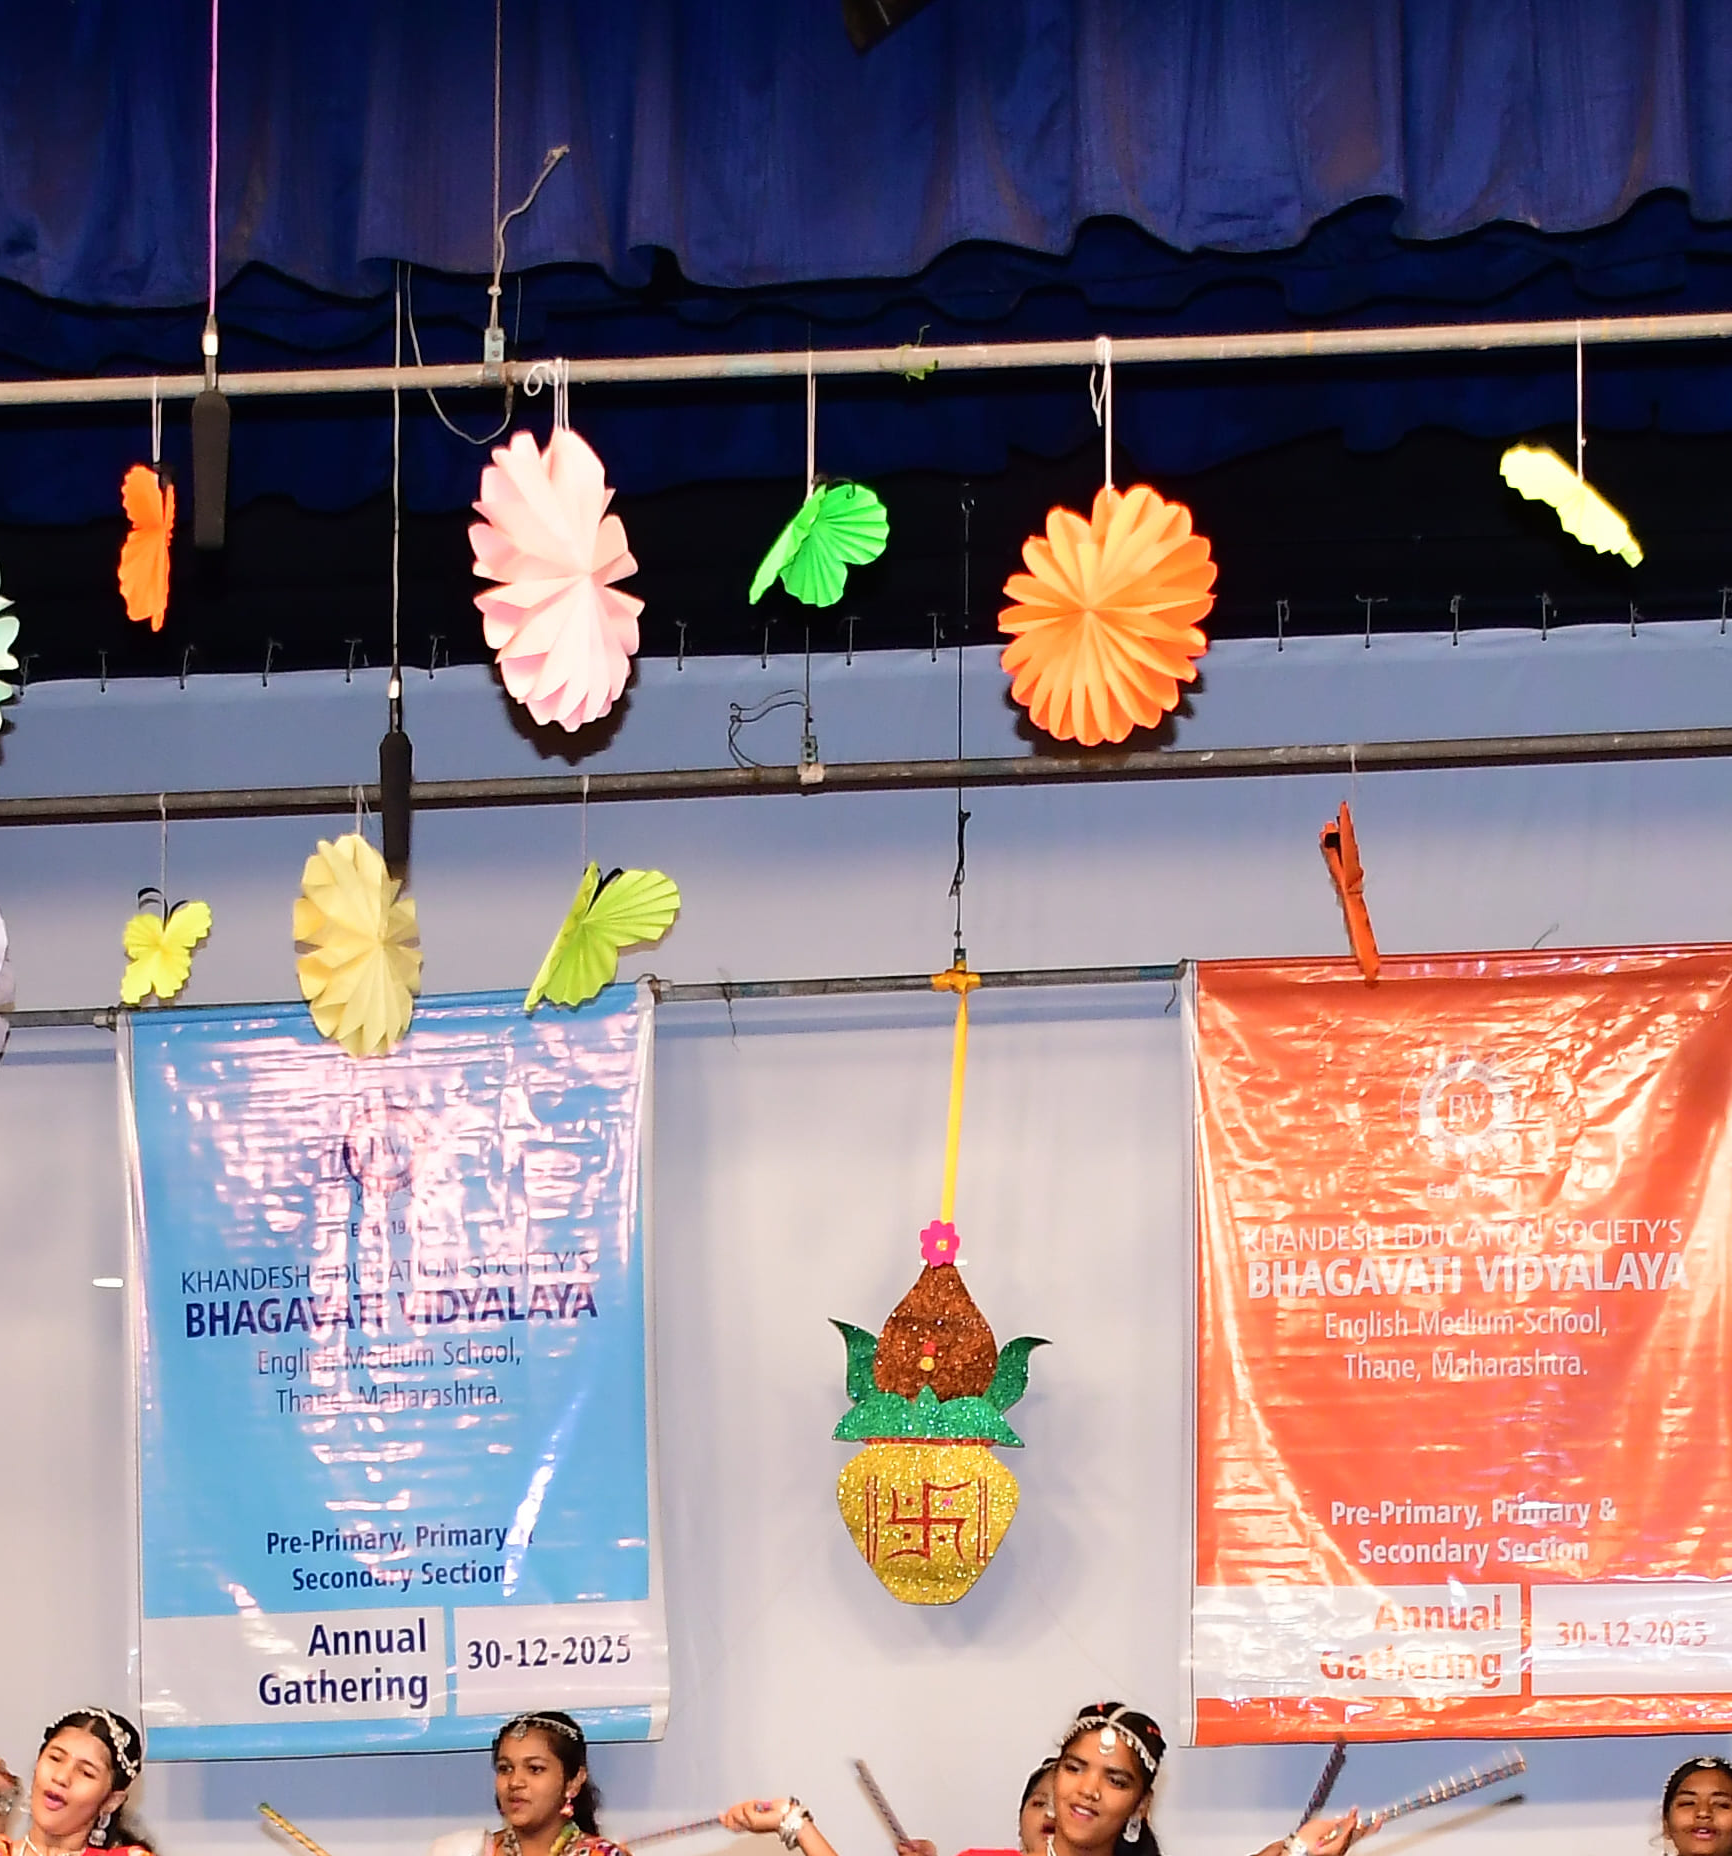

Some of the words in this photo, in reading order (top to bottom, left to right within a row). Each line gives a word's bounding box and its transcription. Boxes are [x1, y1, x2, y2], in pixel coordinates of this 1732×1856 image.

[1245, 1225, 1384, 1252] KHANDESH
[182, 1266, 310, 1294] KHANDESH
[1248, 1256, 1461, 1299] BHAGAVATI
[1476, 1252, 1690, 1292] VIDYALAYA
[186, 1294, 383, 1338] BHAGAVATI
[397, 1284, 598, 1324] VIDYALAYA
[1326, 1310, 1408, 1345] English
[1418, 1307, 1514, 1336] Medium
[1524, 1306, 1607, 1337] School,
[443, 1337, 521, 1366] School,
[1344, 1351, 1421, 1382] Thane,
[1432, 1348, 1589, 1379] Maharashtra.
[358, 1381, 504, 1408] Maharashtra.
[1331, 1499, 1483, 1529] Pre-Primary,
[1599, 1498, 1616, 1521] &
[267, 1528, 406, 1554] Pre-Primary,
[416, 1525, 507, 1550] Primary
[1359, 1537, 1489, 1568] Secondary
[1497, 1536, 1588, 1562] Section
[293, 1564, 413, 1592] Secondary
[421, 1560, 505, 1585] Section
[1374, 1594, 1501, 1632] Annual
[308, 1618, 426, 1656] Annual
[467, 1634, 631, 1670] 30-12-2025
[259, 1667, 428, 1709] Gathering
